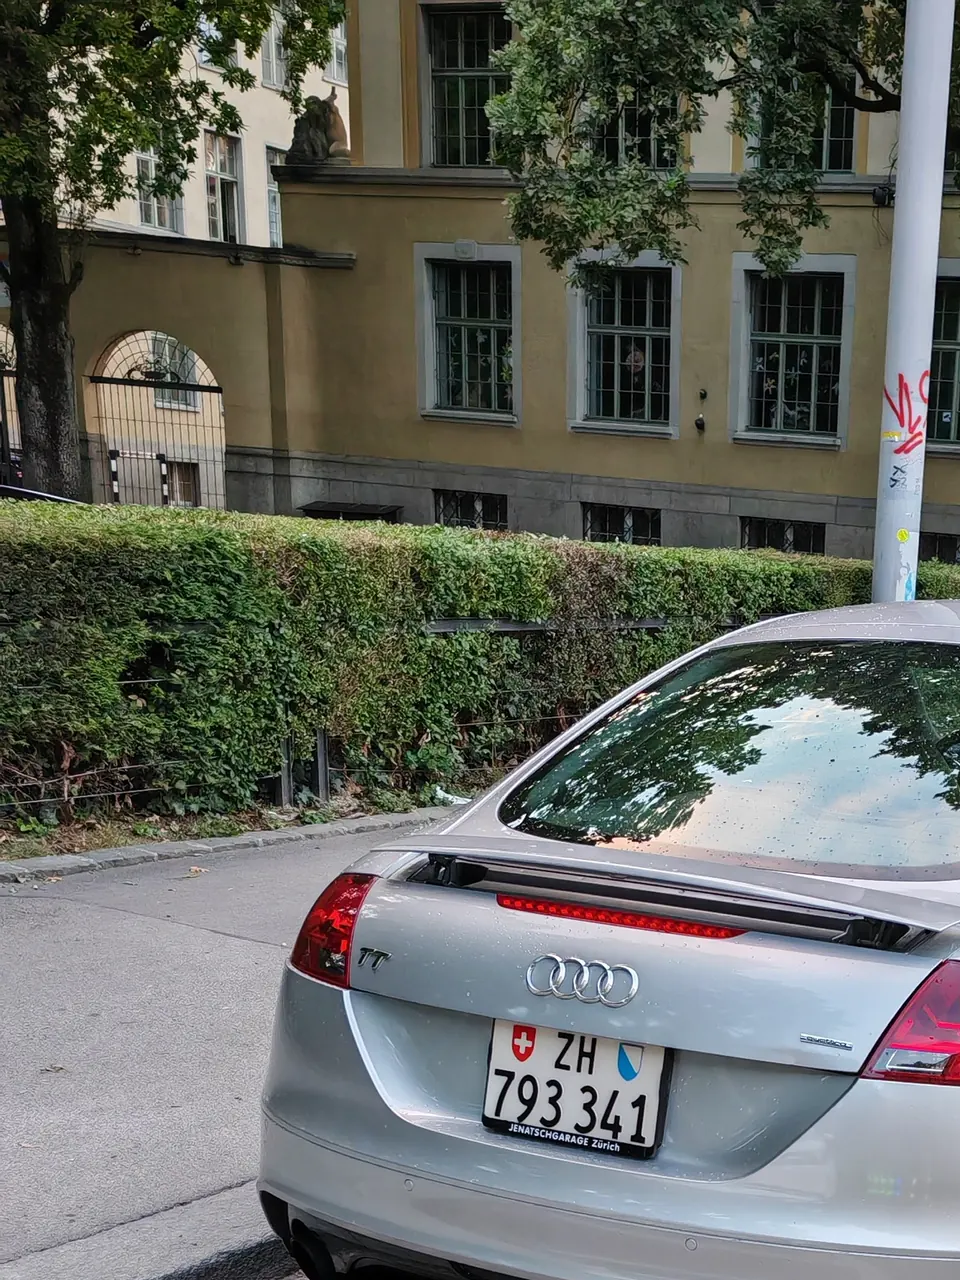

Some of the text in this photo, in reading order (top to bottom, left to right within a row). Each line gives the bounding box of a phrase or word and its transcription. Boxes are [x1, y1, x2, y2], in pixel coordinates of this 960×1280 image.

[358, 946, 392, 970] TT
[554, 1031, 597, 1075] ZH
[494, 1068, 647, 1144] 793 341
[508, 1122, 620, 1152] JENATSCHGARAGE Zürich
